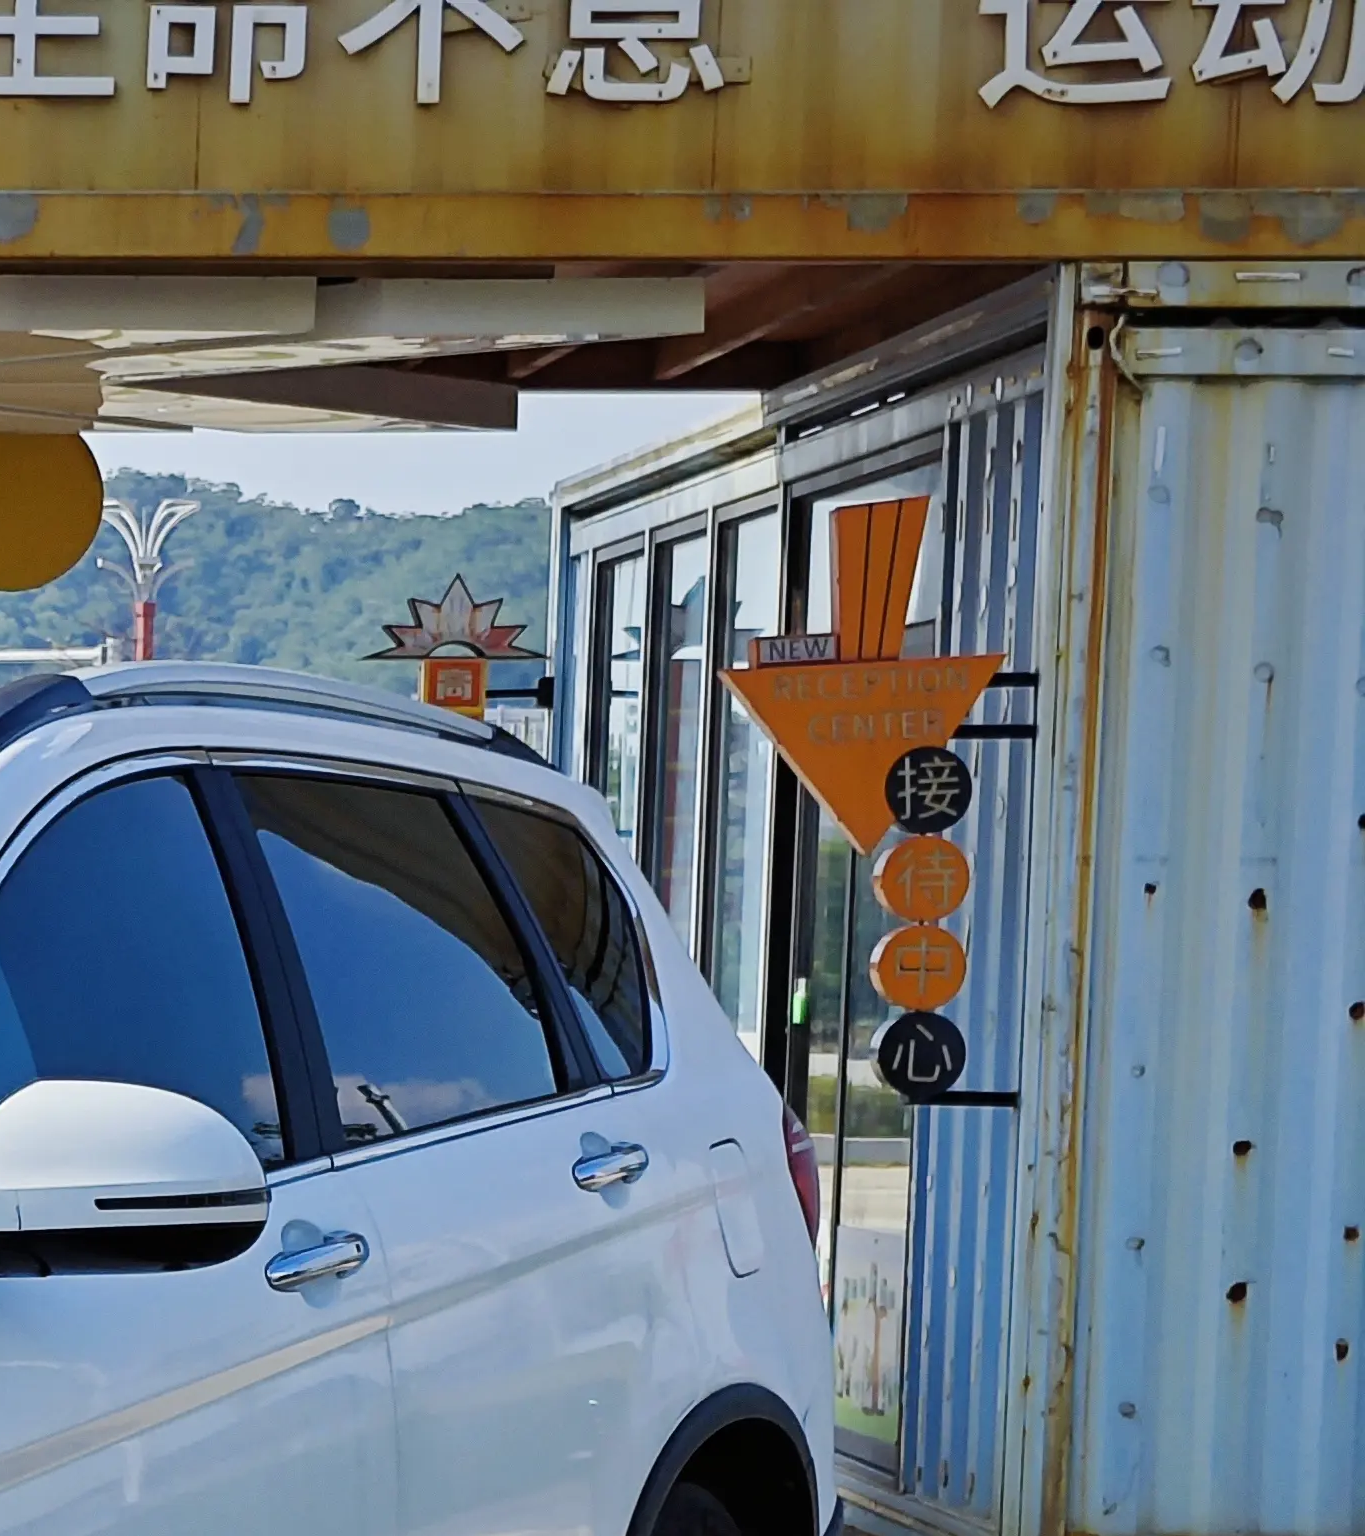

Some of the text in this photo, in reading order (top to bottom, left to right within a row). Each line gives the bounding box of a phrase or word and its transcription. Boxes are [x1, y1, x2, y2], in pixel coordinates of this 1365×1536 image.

[769, 637, 830, 662] NEW
[773, 665, 968, 702] RECEPTION
[807, 708, 945, 744] CENTER
[892, 754, 962, 1083] 接待中心
